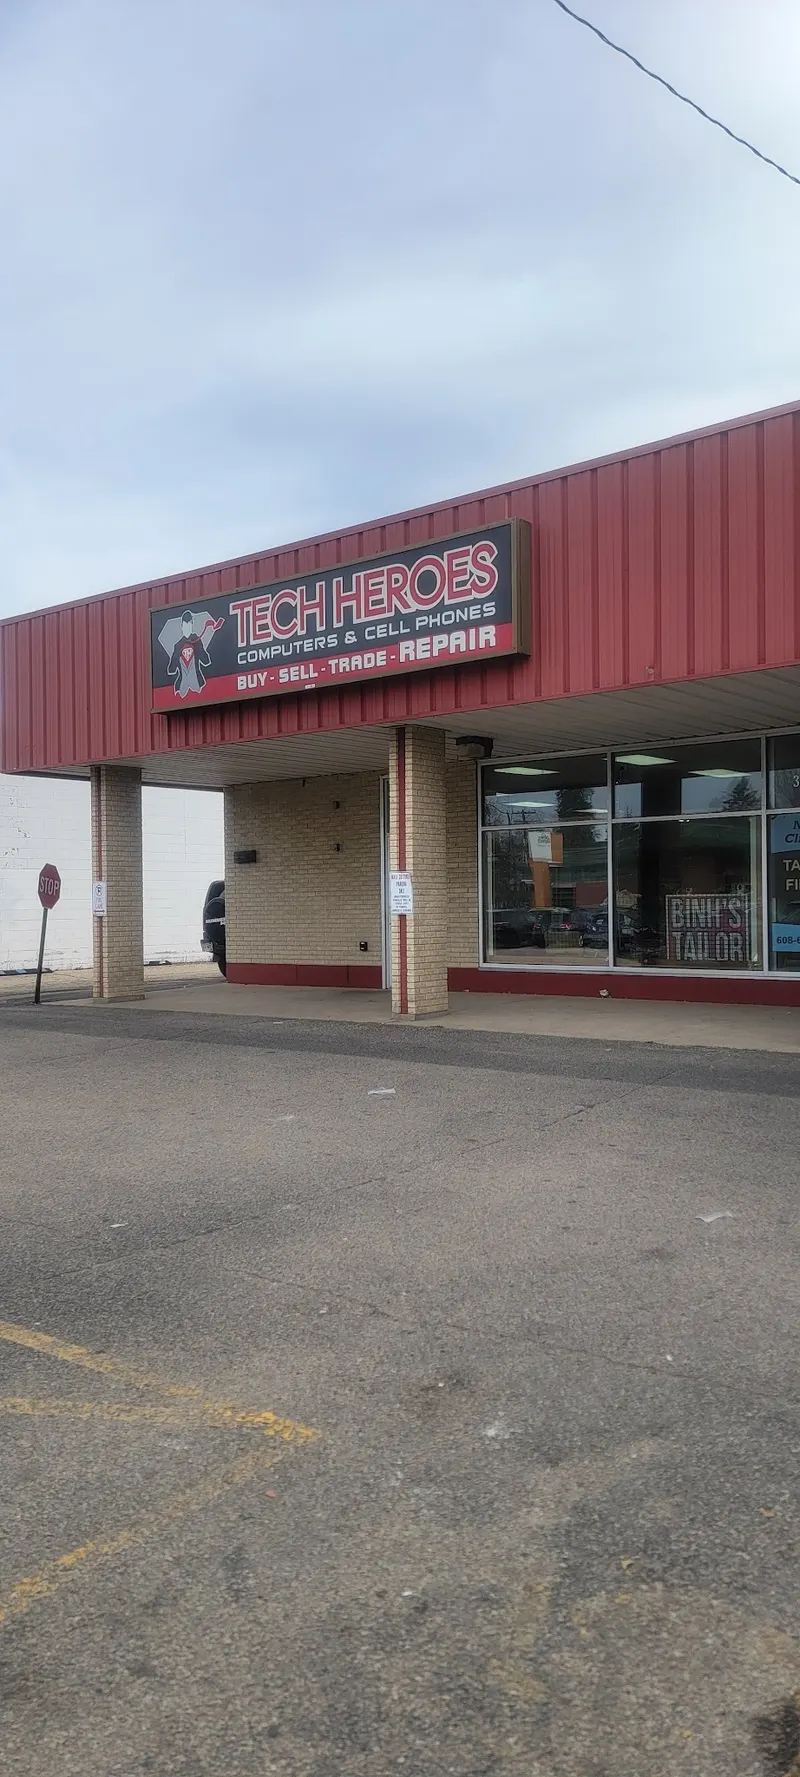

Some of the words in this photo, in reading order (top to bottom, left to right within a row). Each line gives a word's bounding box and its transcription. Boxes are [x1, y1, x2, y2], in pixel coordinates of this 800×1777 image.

[230, 581, 326, 648] TECH
[333, 540, 499, 628] HEROES
[237, 634, 338, 664] COMPUTERS
[344, 630, 358, 644] &
[365, 620, 411, 640] CELL
[415, 602, 496, 630] PHONES
[237, 671, 268, 690] BUY
[279, 663, 319, 683] SELL
[328, 650, 387, 674] TRADE
[399, 625, 496, 662] REPAIR
[39, 876, 60, 896] STOP
[671, 898, 742, 928] BINH'S
[671, 931, 744, 961] TAILOR
